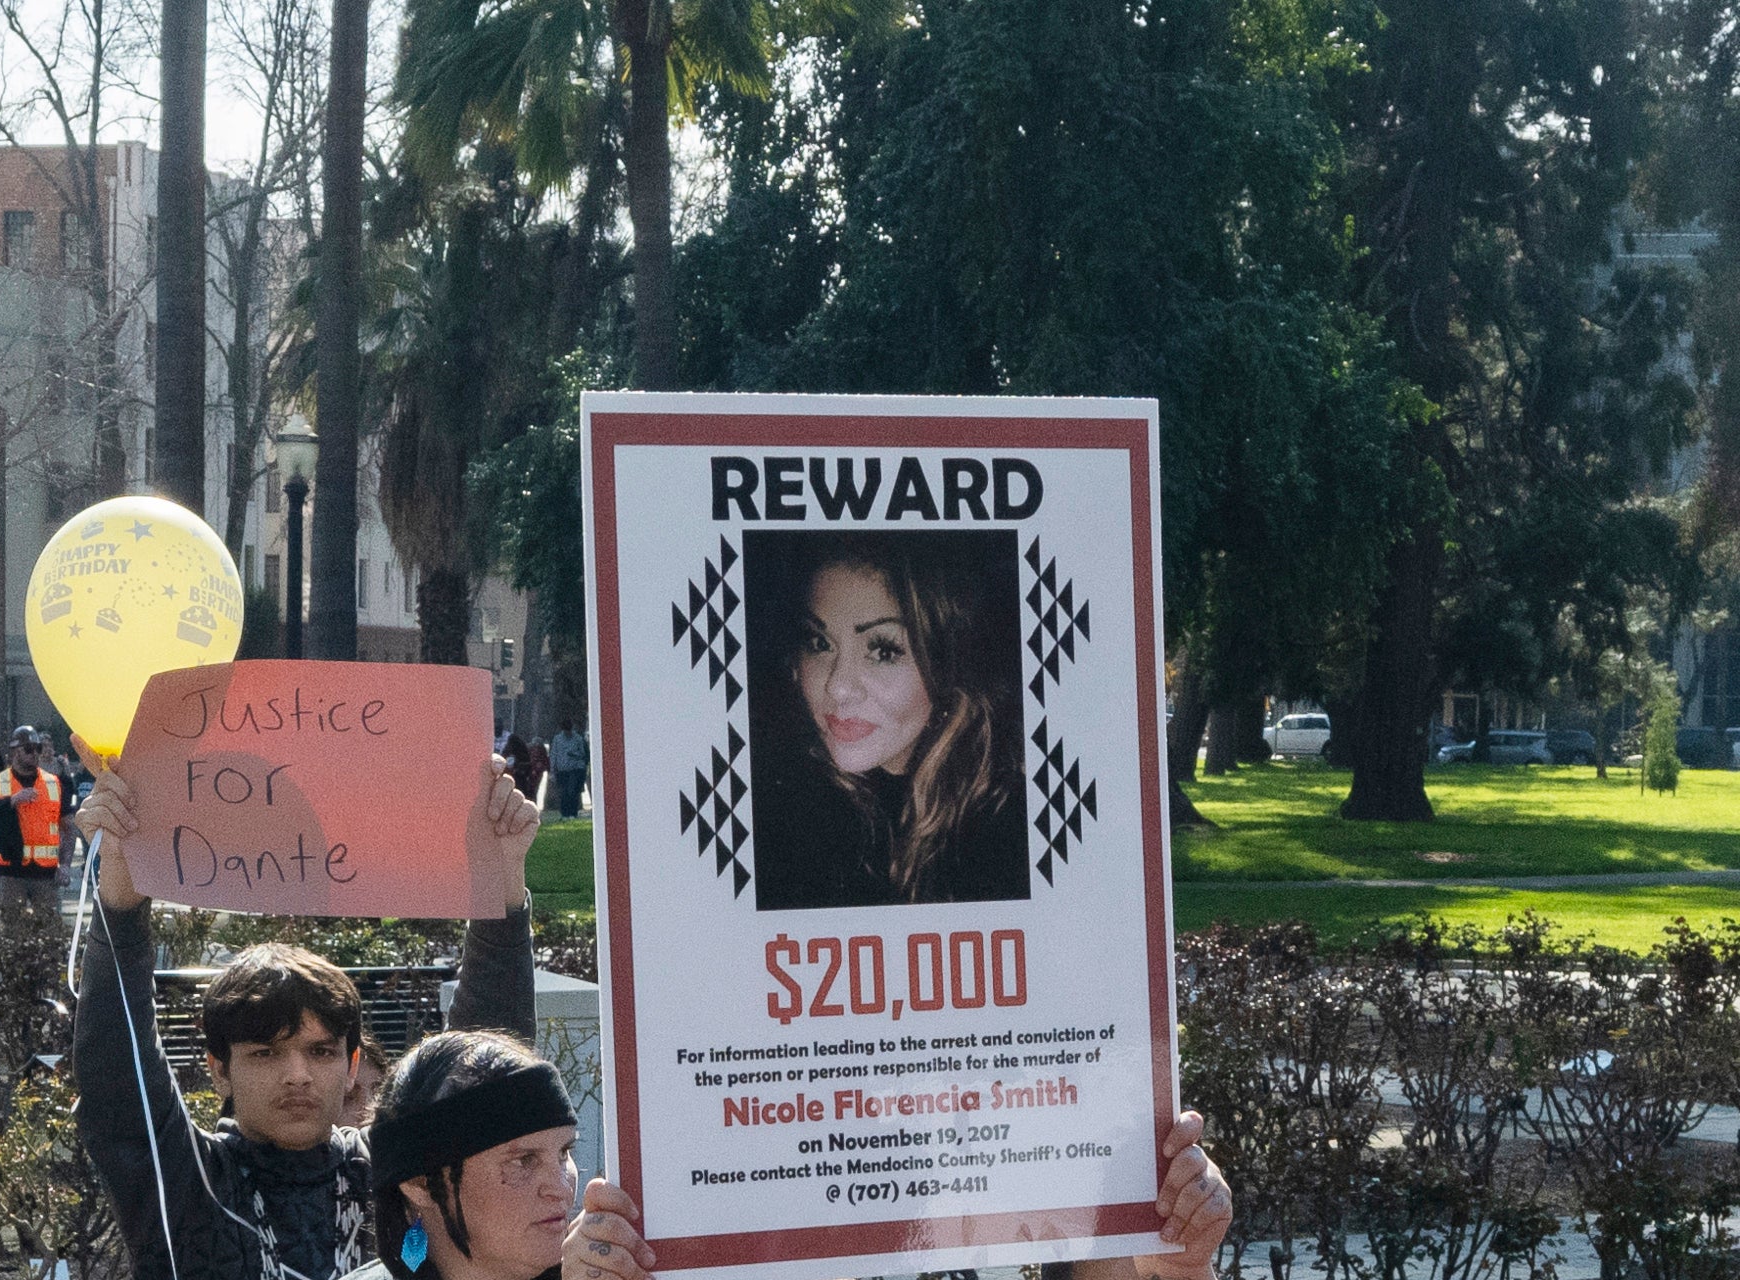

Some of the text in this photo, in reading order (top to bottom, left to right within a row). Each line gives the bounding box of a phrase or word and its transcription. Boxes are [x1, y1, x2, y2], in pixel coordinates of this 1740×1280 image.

[710, 456, 1044, 521] REWARD
[44, 558, 132, 584] BIRTHDAY
[59, 543, 121, 562] HAPPY
[162, 685, 389, 739] Justice
[173, 825, 357, 889] Dante
[765, 929, 1027, 1025] $20,000
[677, 1024, 1115, 1064] For information leading to the arrest and conviction of
[695, 1047, 1101, 1087] the person or persons responsible for the murder of
[723, 1076, 1078, 1127] Nicole Florencia Smith
[798, 1124, 1010, 1154] on November 19, 2017
[691, 1142, 1112, 1186] Please contact the Mendocino County Sheriff's Office
[826, 1175, 988, 1206] @ (707) 463-4411
